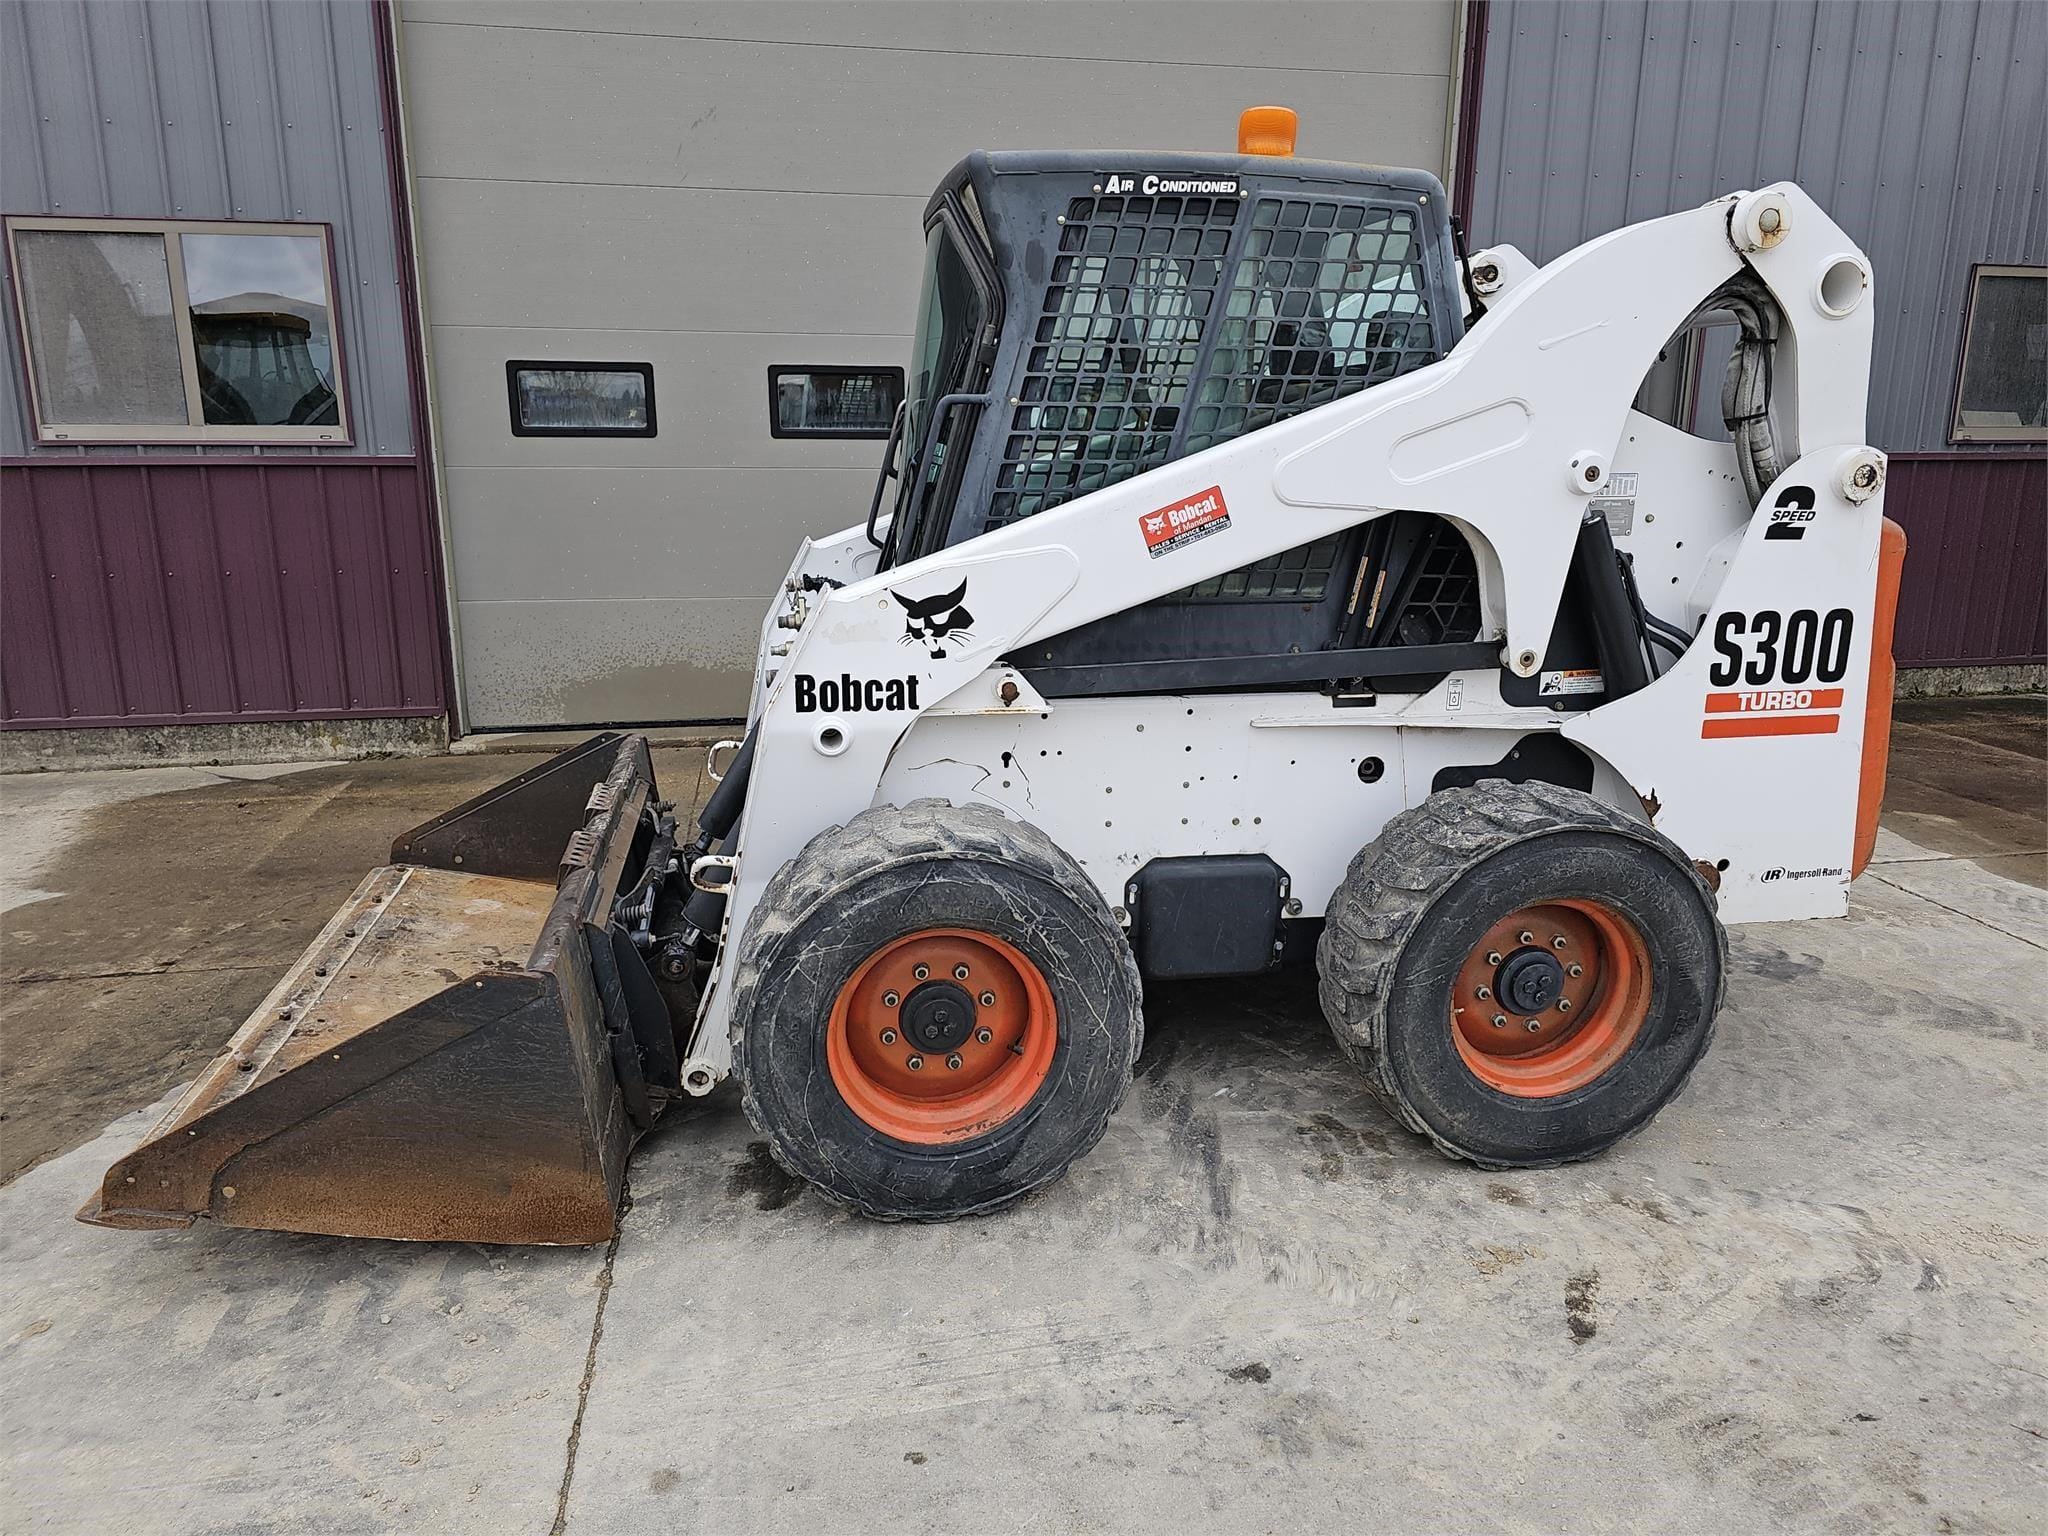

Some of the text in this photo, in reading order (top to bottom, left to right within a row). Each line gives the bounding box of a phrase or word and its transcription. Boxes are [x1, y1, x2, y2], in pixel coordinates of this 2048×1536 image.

[1104, 175, 1237, 195] AIR CONDITIONED
[1168, 495, 1217, 528] Bobcat
[1770, 510, 1817, 522] SPEED
[1150, 517, 1228, 552] SALES SERVICE RENTAL
[1173, 515, 1213, 536] of Mandan
[1175, 539, 1191, 549] STRIP
[1709, 608, 1854, 687] S300
[794, 673, 920, 713] Bobcat
[1737, 690, 1813, 711] TURBO
